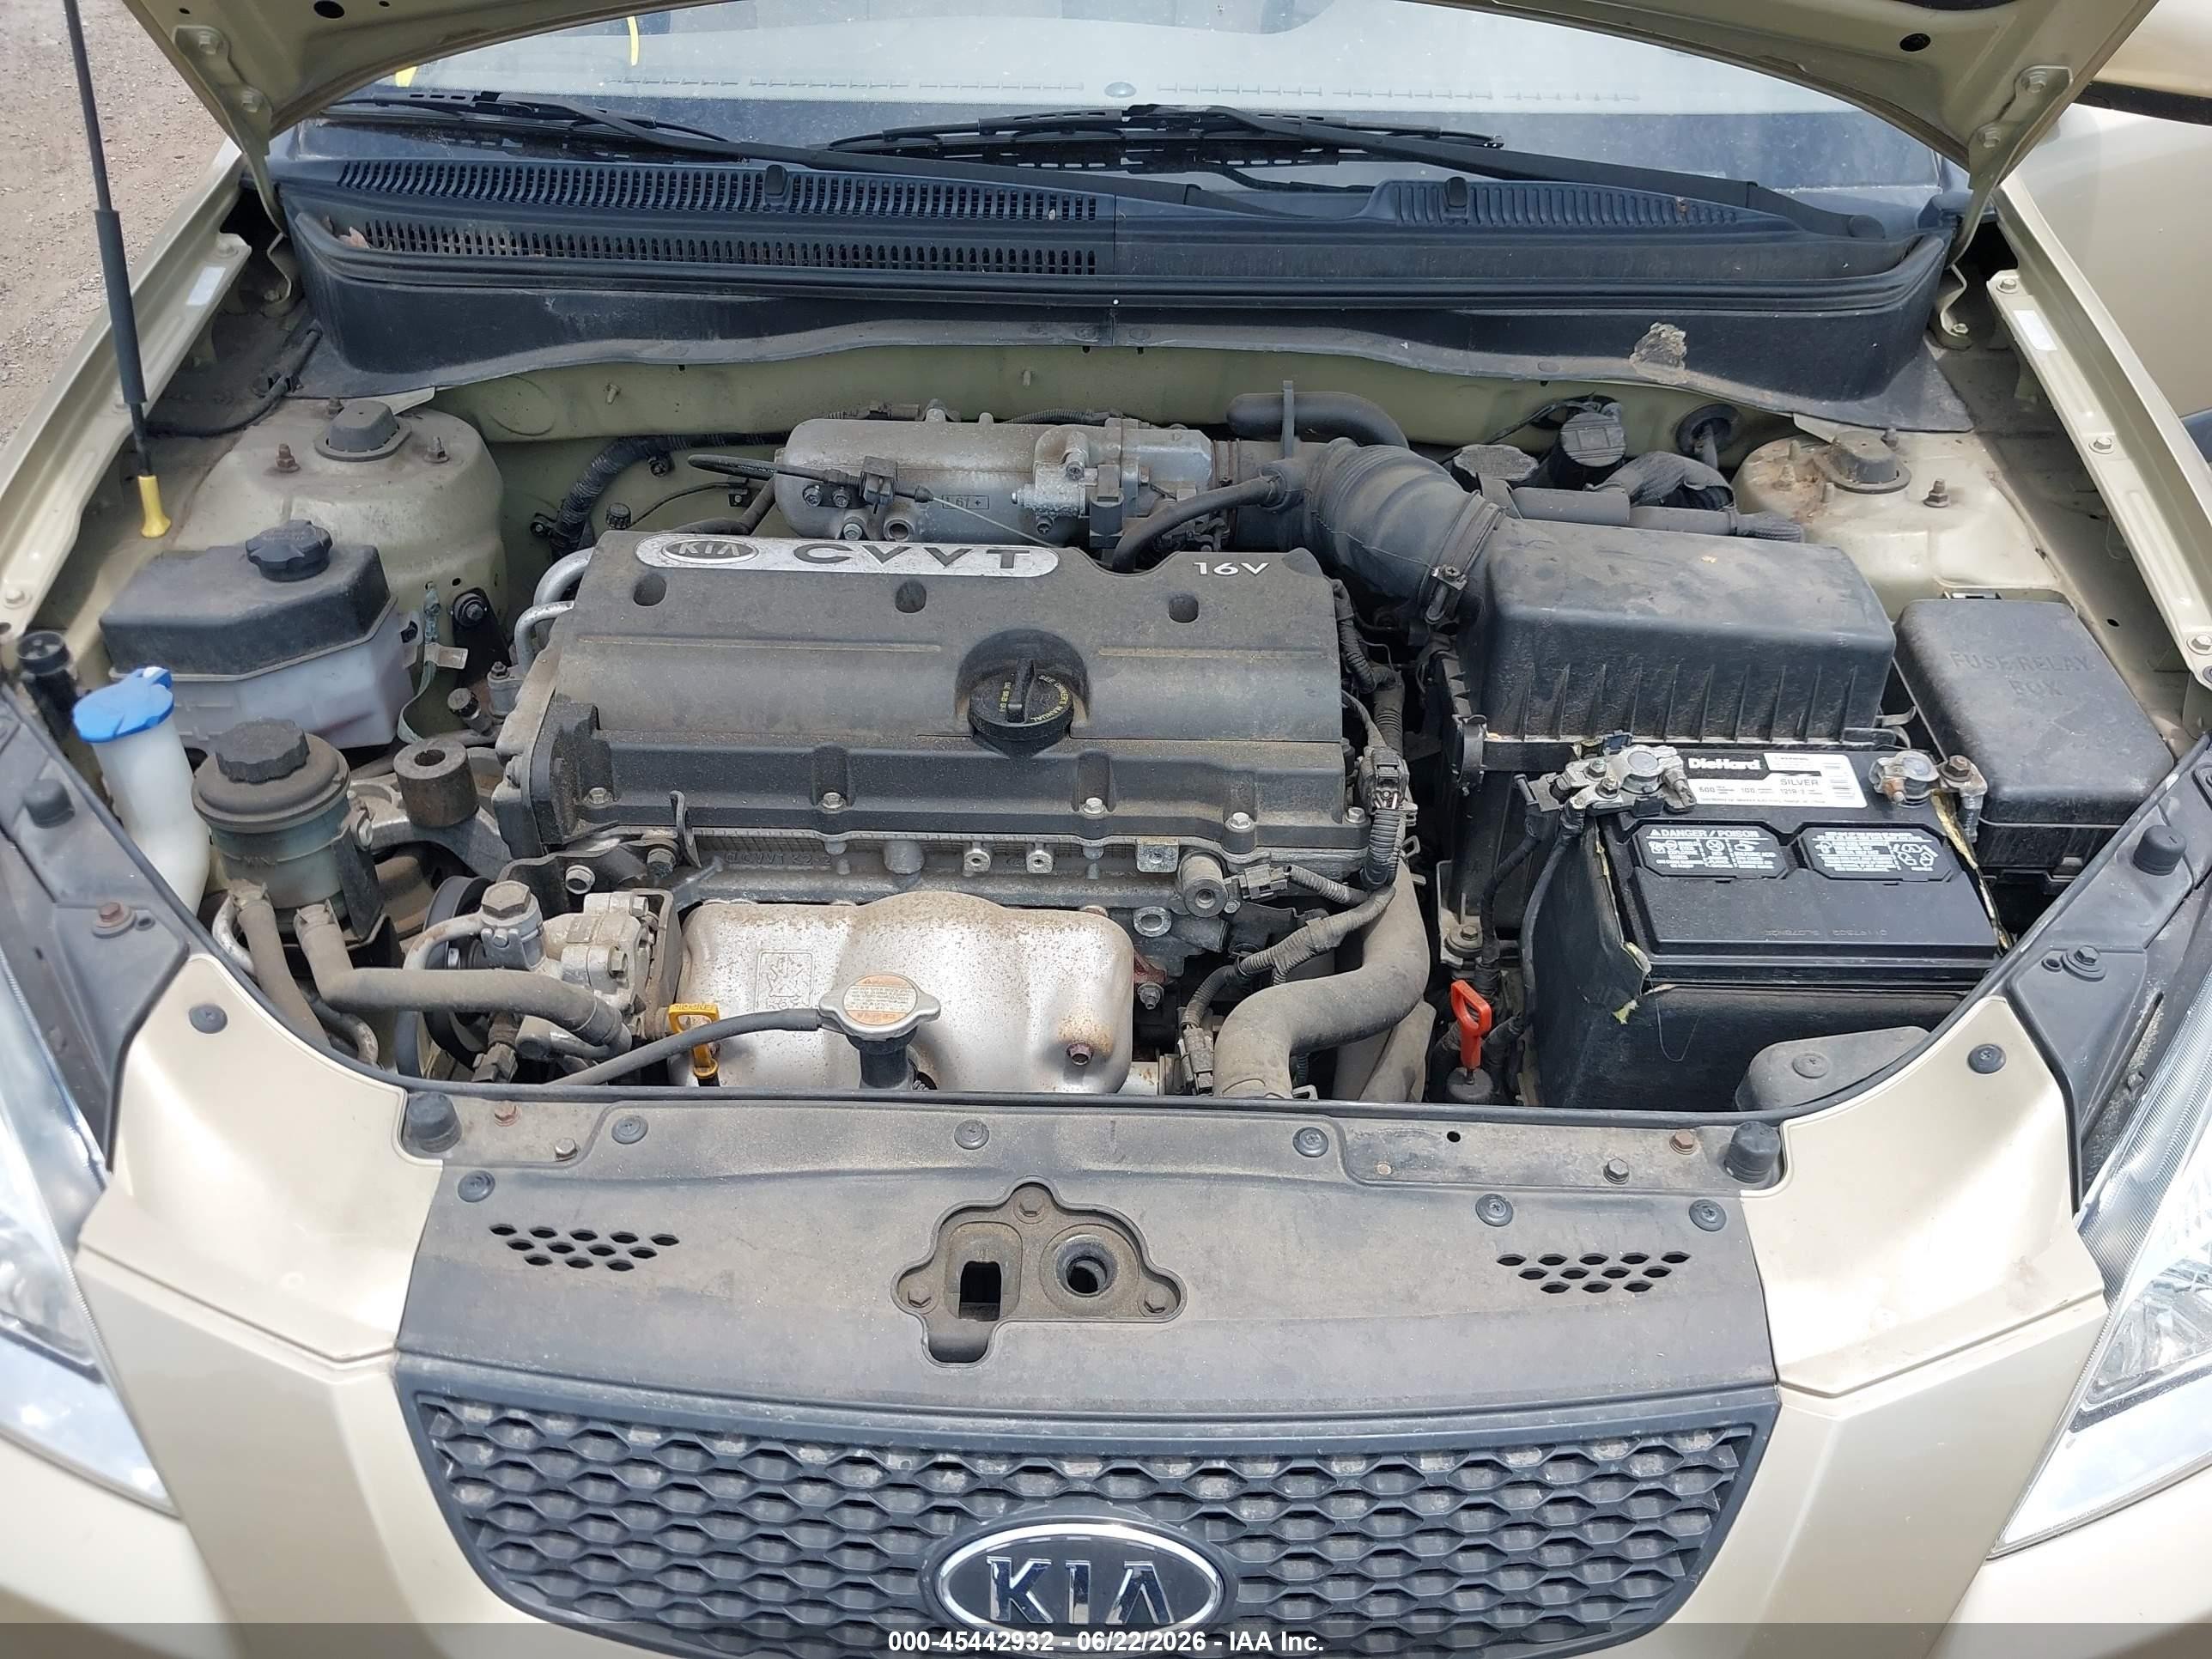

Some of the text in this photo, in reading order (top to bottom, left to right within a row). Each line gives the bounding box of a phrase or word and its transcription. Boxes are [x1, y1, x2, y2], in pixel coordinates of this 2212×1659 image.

[677, 540, 743, 557] KIA
[793, 543, 1031, 570] CVVT
[1193, 562, 1270, 576] 16V
[1038, 674, 1054, 684] SEE
[1030, 705, 1064, 722] MANUAL
[1687, 757, 1763, 771] DieHard
[1780, 777, 1819, 787] SILVER
[1660, 829, 1707, 837] DANGER
[1717, 830, 1760, 838] POISON
[986, 1555, 1176, 1626] KIA
